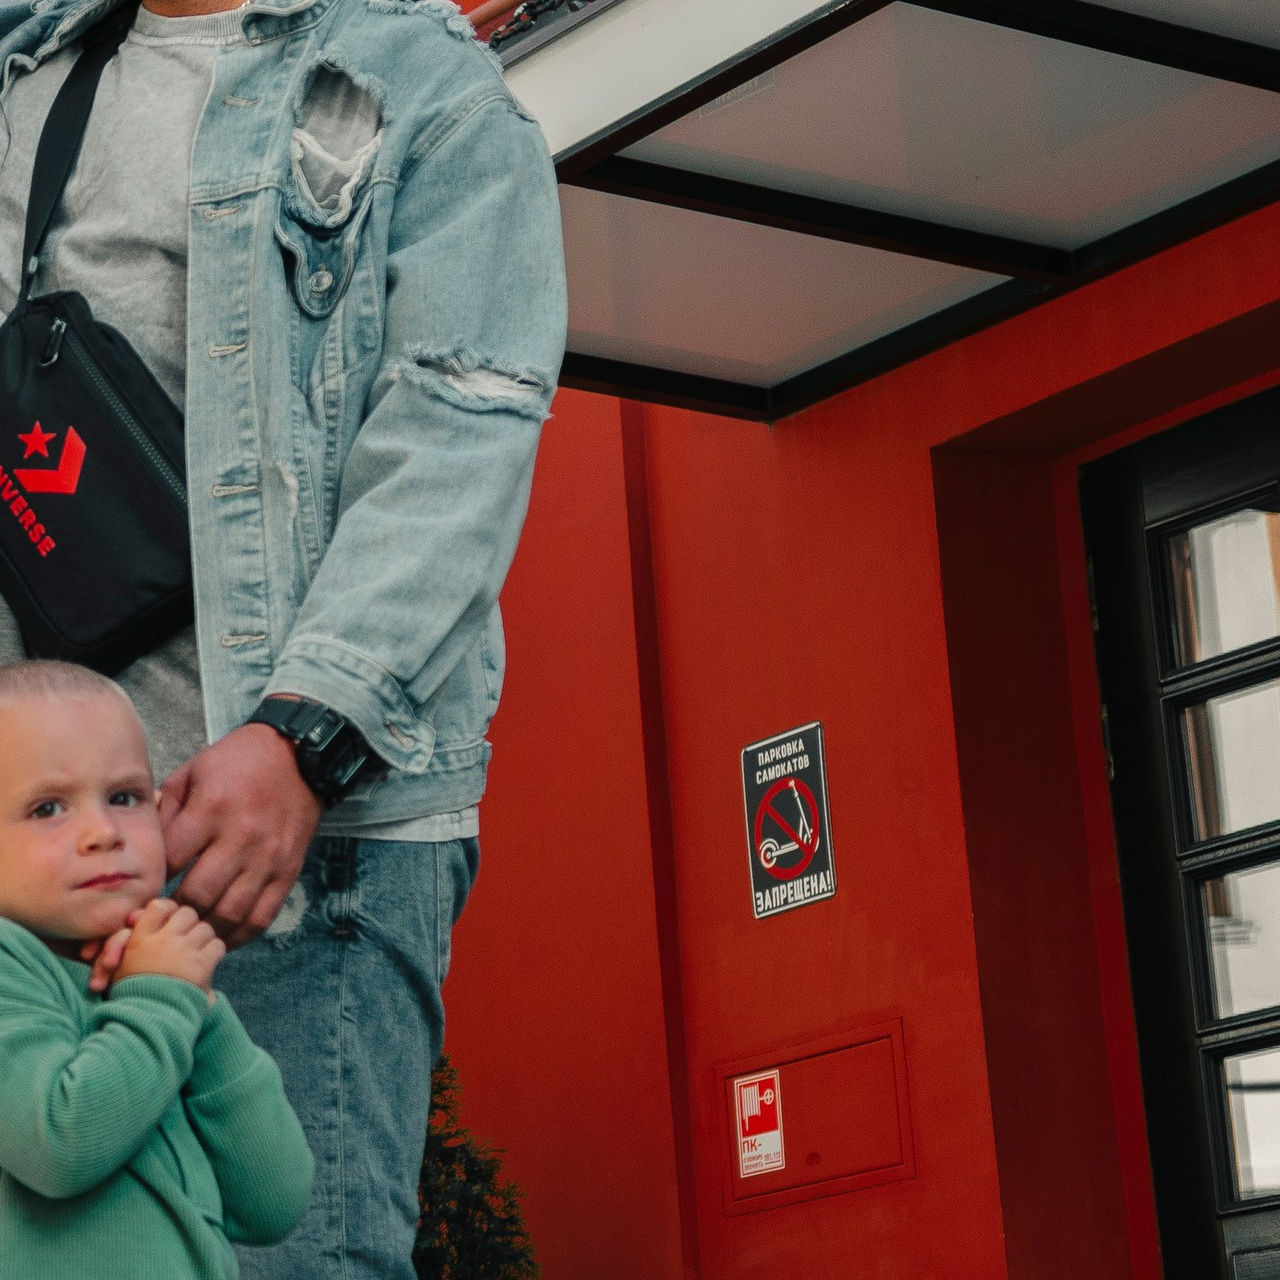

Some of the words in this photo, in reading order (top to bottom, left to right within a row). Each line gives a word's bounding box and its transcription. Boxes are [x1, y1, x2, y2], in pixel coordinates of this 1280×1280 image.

[757, 738, 805, 767] ПАРКОВКА
[756, 754, 810, 785] САМОКАТОВ
[755, 870, 833, 913] ЗАПРЕЩЕНА!
